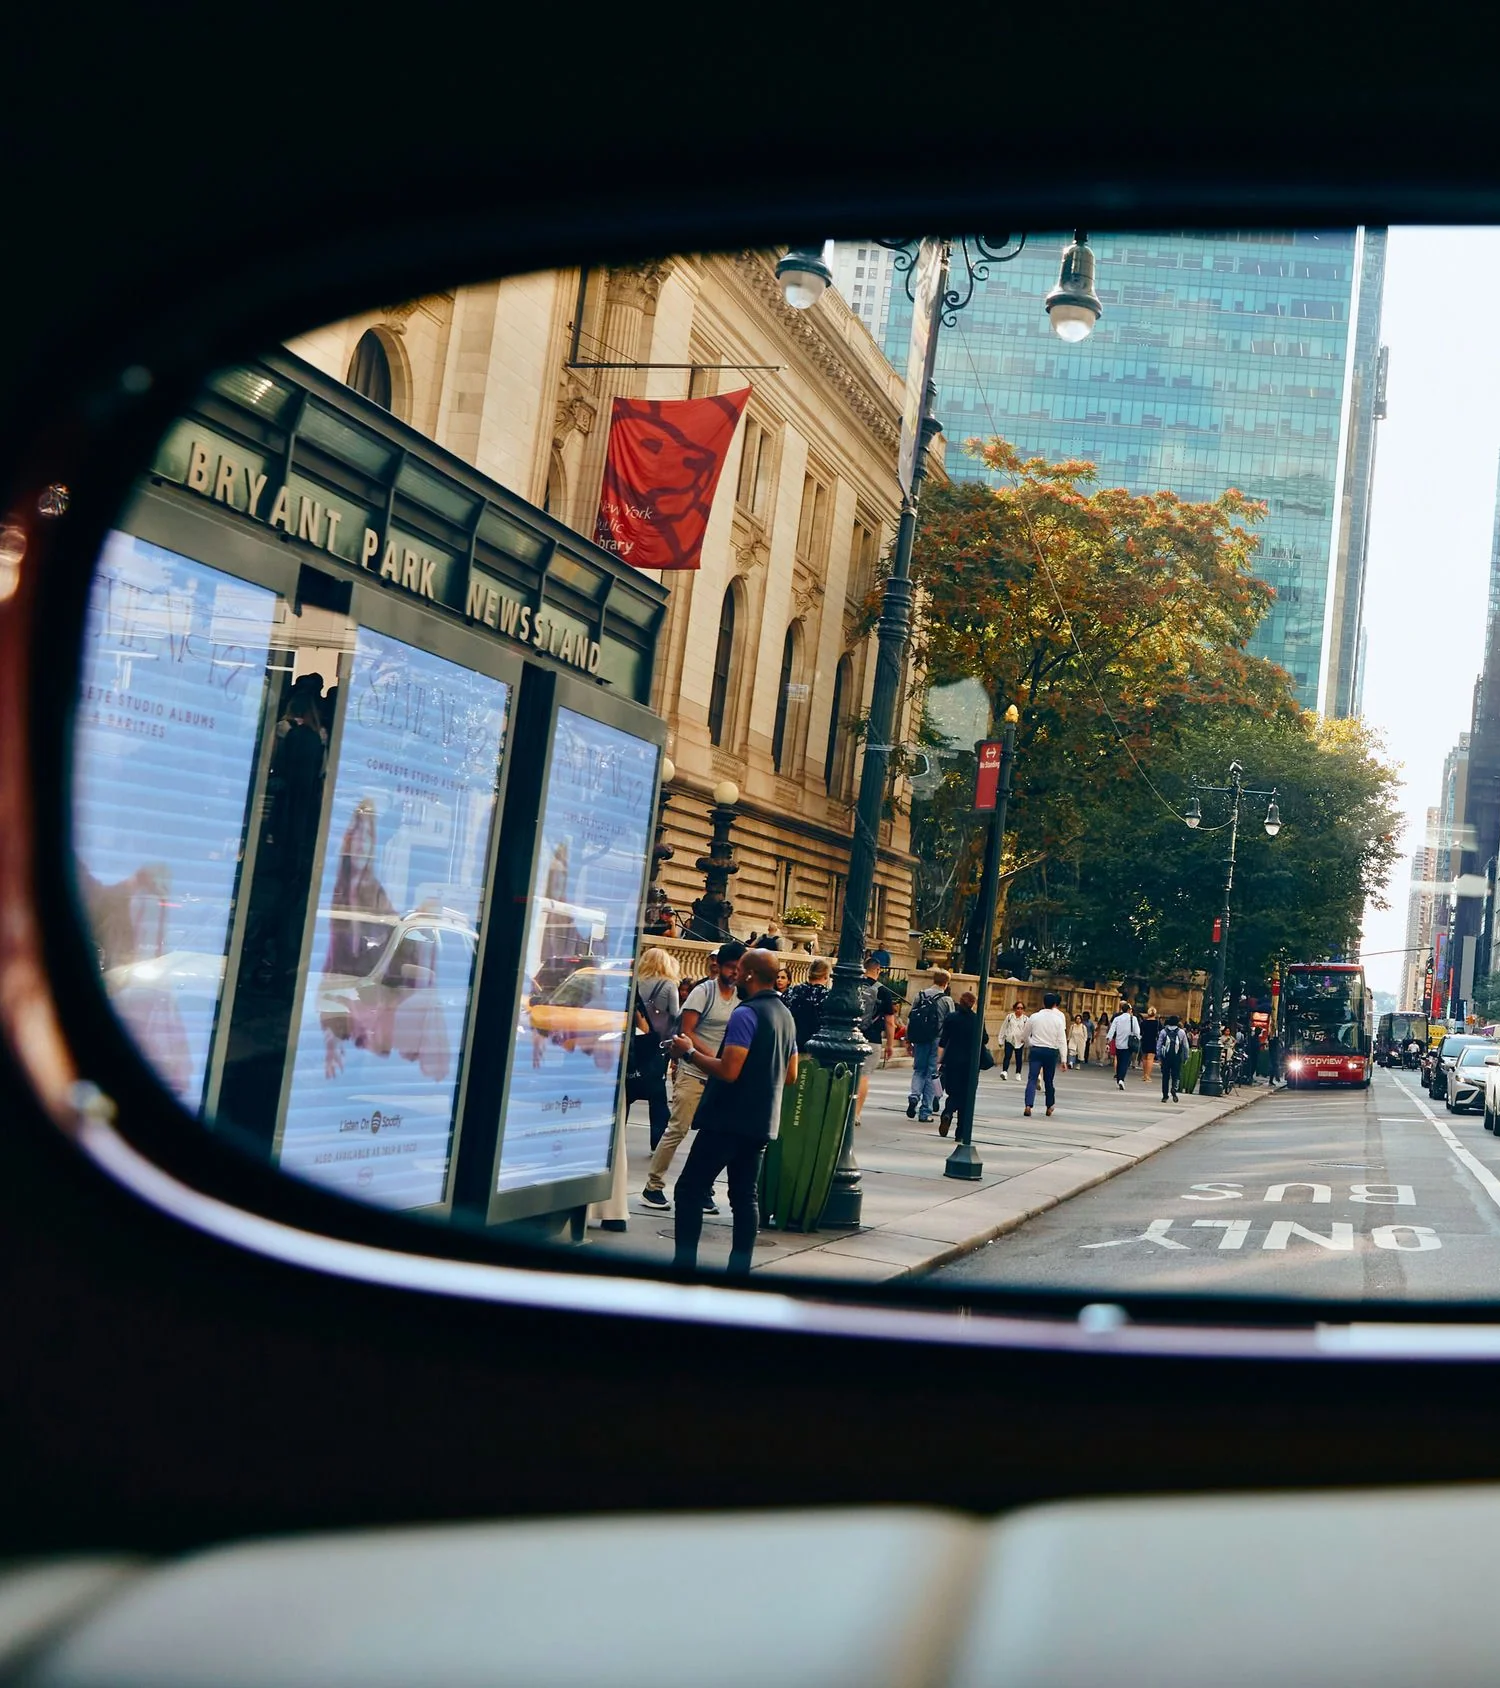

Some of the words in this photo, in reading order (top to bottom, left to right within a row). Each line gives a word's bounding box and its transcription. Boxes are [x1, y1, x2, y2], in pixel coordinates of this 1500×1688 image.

[625, 504, 652, 520] York
[599, 535, 634, 556] brary
[186, 441, 341, 552] BRYANT
[361, 527, 437, 599] PARK
[466, 579, 601, 676] NEWSSTAND
[118, 692, 164, 717] STUDIO
[169, 708, 216, 730] ALBUMS
[108, 713, 166, 738] RARITIES
[367, 758, 409, 778] COMPLETE
[412, 768, 438, 786] STUDIO
[1424, 974, 1432, 998] REGAL
[794, 1093, 804, 1126] BRYANT
[360, 1118, 369, 1130] On
[1181, 1182, 1416, 1206] BUS
[1078, 1220, 1444, 1252] ONLY
